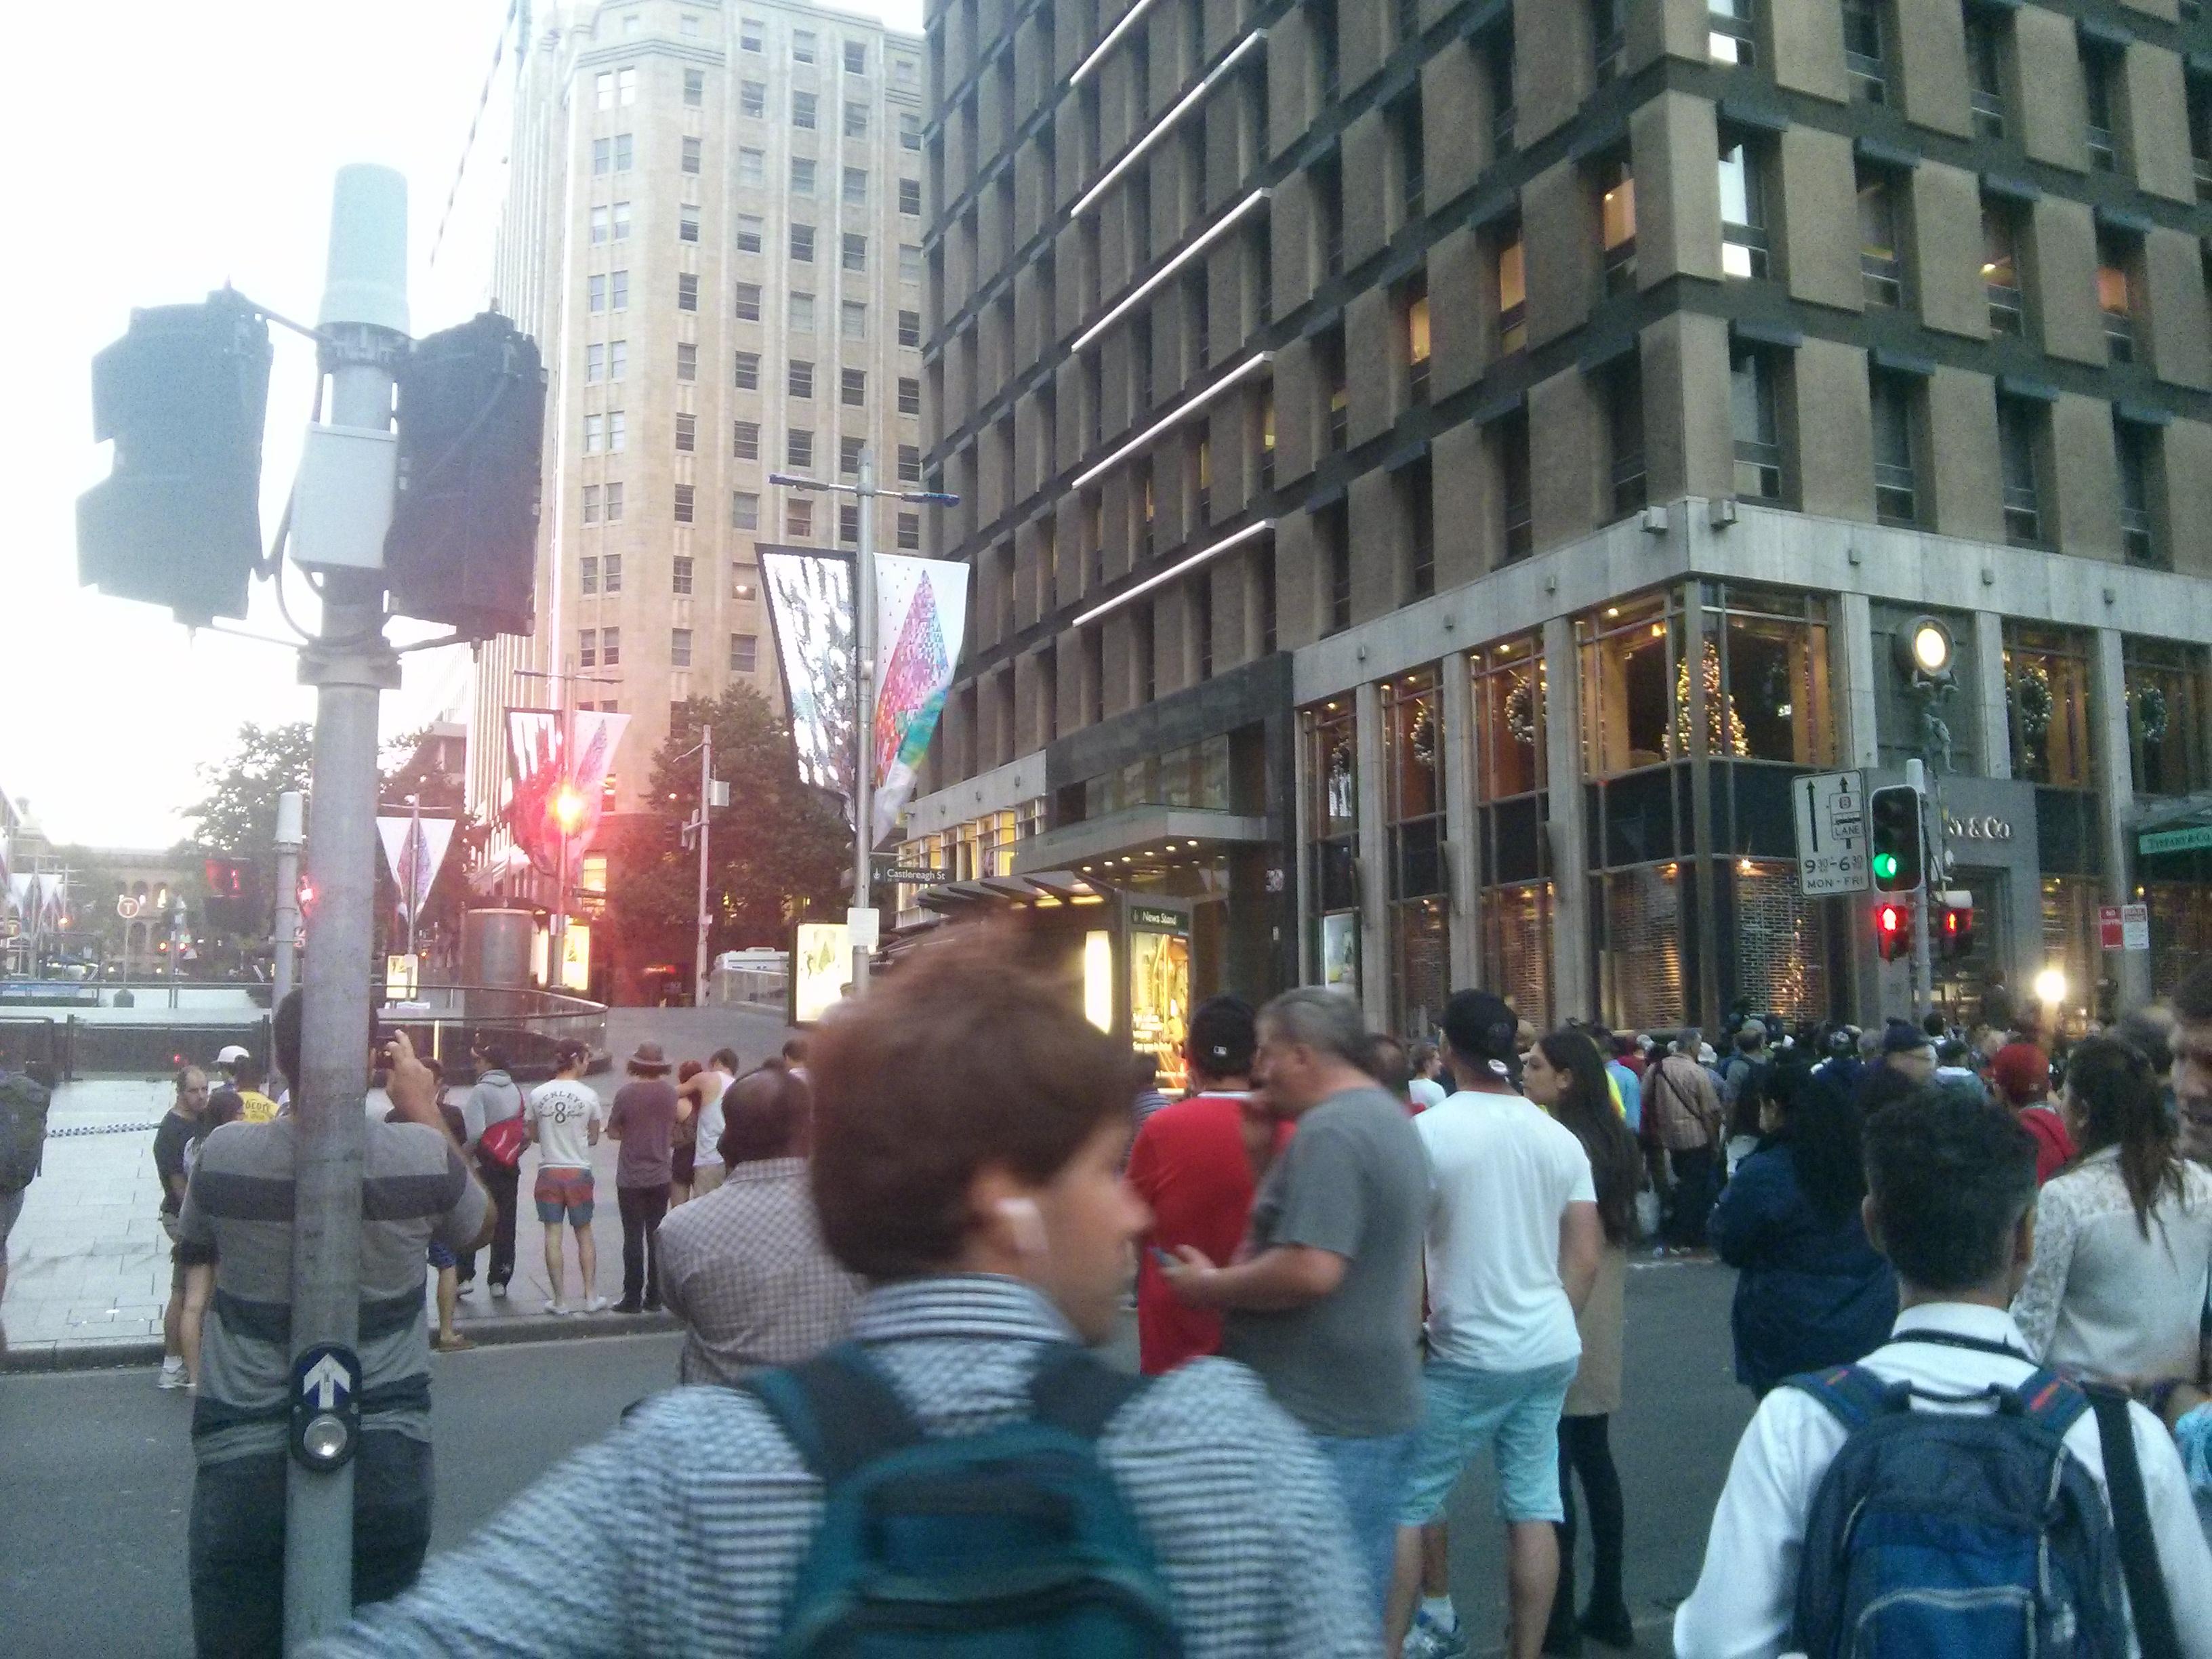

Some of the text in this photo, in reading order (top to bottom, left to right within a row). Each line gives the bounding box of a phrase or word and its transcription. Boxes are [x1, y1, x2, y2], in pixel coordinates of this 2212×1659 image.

[1835, 825, 1860, 836] LANE
[886, 868, 945, 881] Castlereagh St
[1807, 878, 1832, 888] MON
[1843, 876, 1863, 885] FRI
[1142, 911, 1177, 926] News Stand
[538, 1090, 586, 1110] HENLEYS
[554, 1101, 566, 1124] 8
